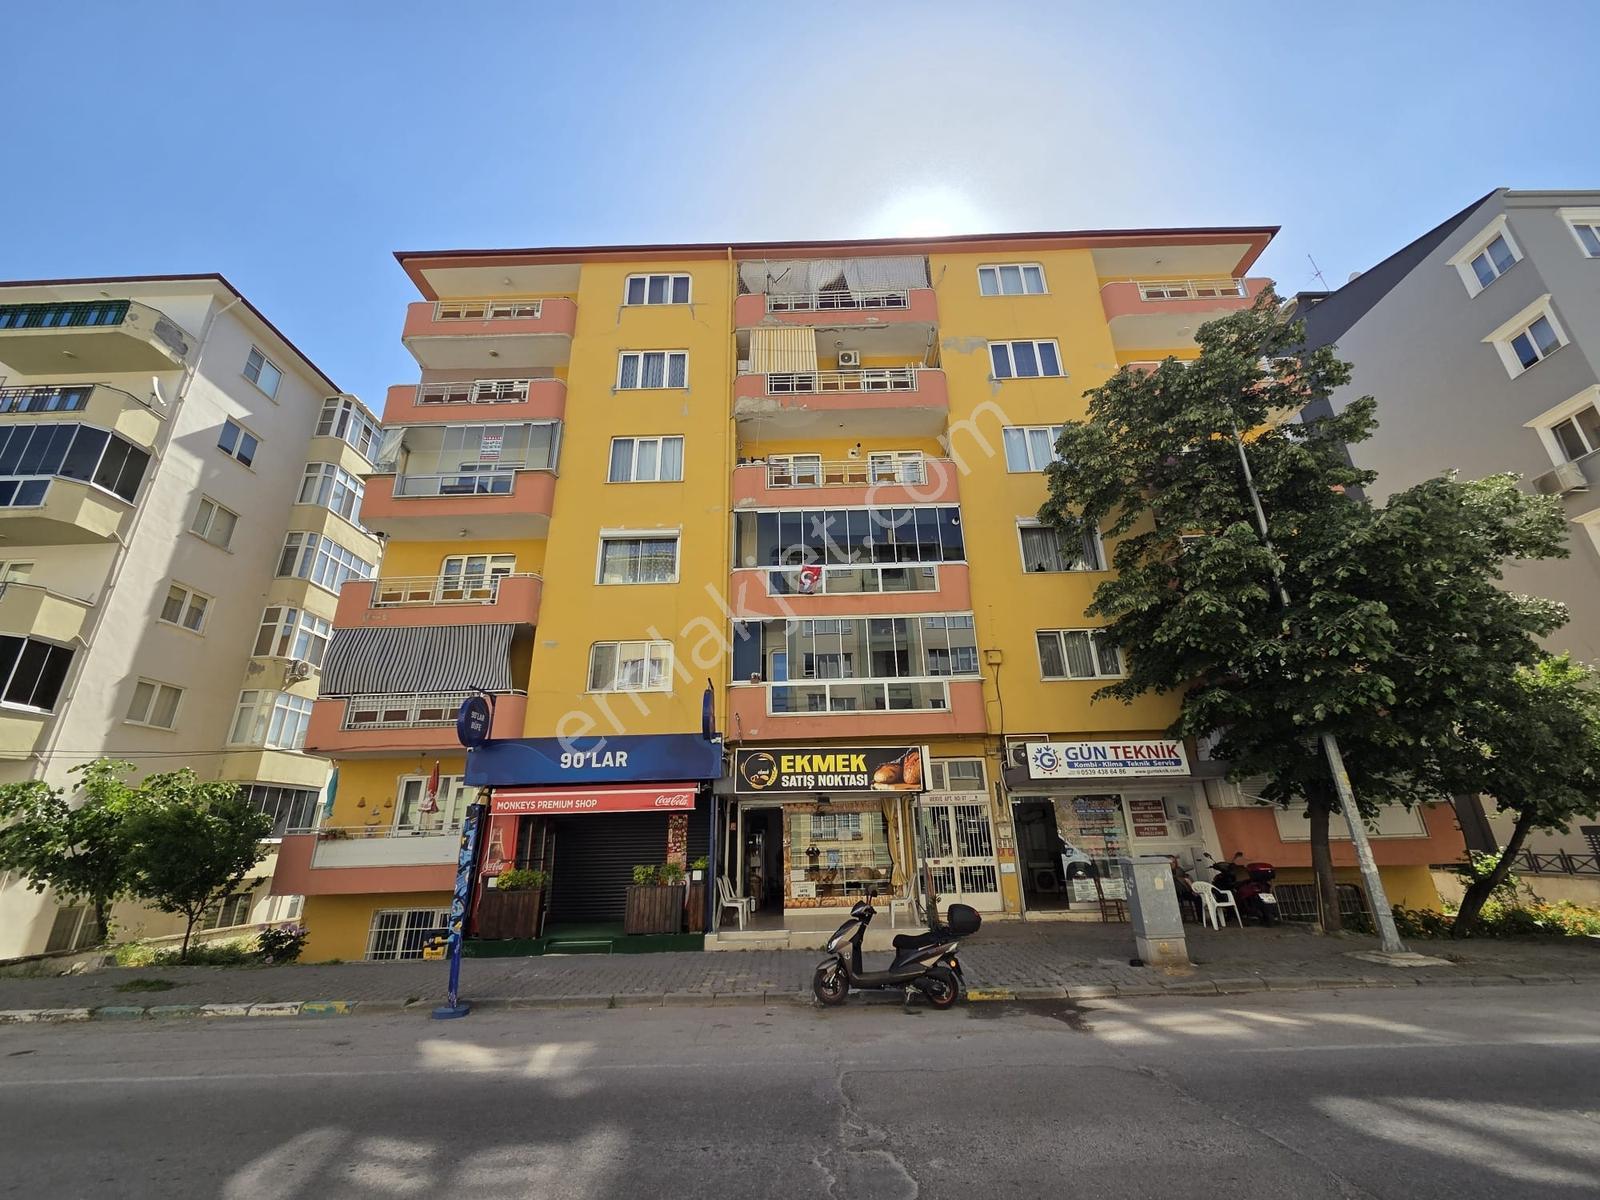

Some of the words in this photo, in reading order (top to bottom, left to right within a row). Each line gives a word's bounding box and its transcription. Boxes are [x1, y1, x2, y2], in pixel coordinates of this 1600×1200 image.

[470, 711, 485, 721] 90'LAR
[1065, 744, 1107, 760] GÜN
[1110, 742, 1180, 759] TEKNİK
[559, 750, 628, 769] 90'LAR
[780, 754, 867, 773] EKMEK
[1103, 760, 1123, 768] Klima
[781, 774, 815, 789] SATIŞ
[817, 773, 868, 787] NOKTASI
[497, 799, 536, 810] MONKEYS
[537, 799, 574, 809] PREMIUM
[575, 798, 598, 808] SHOP
